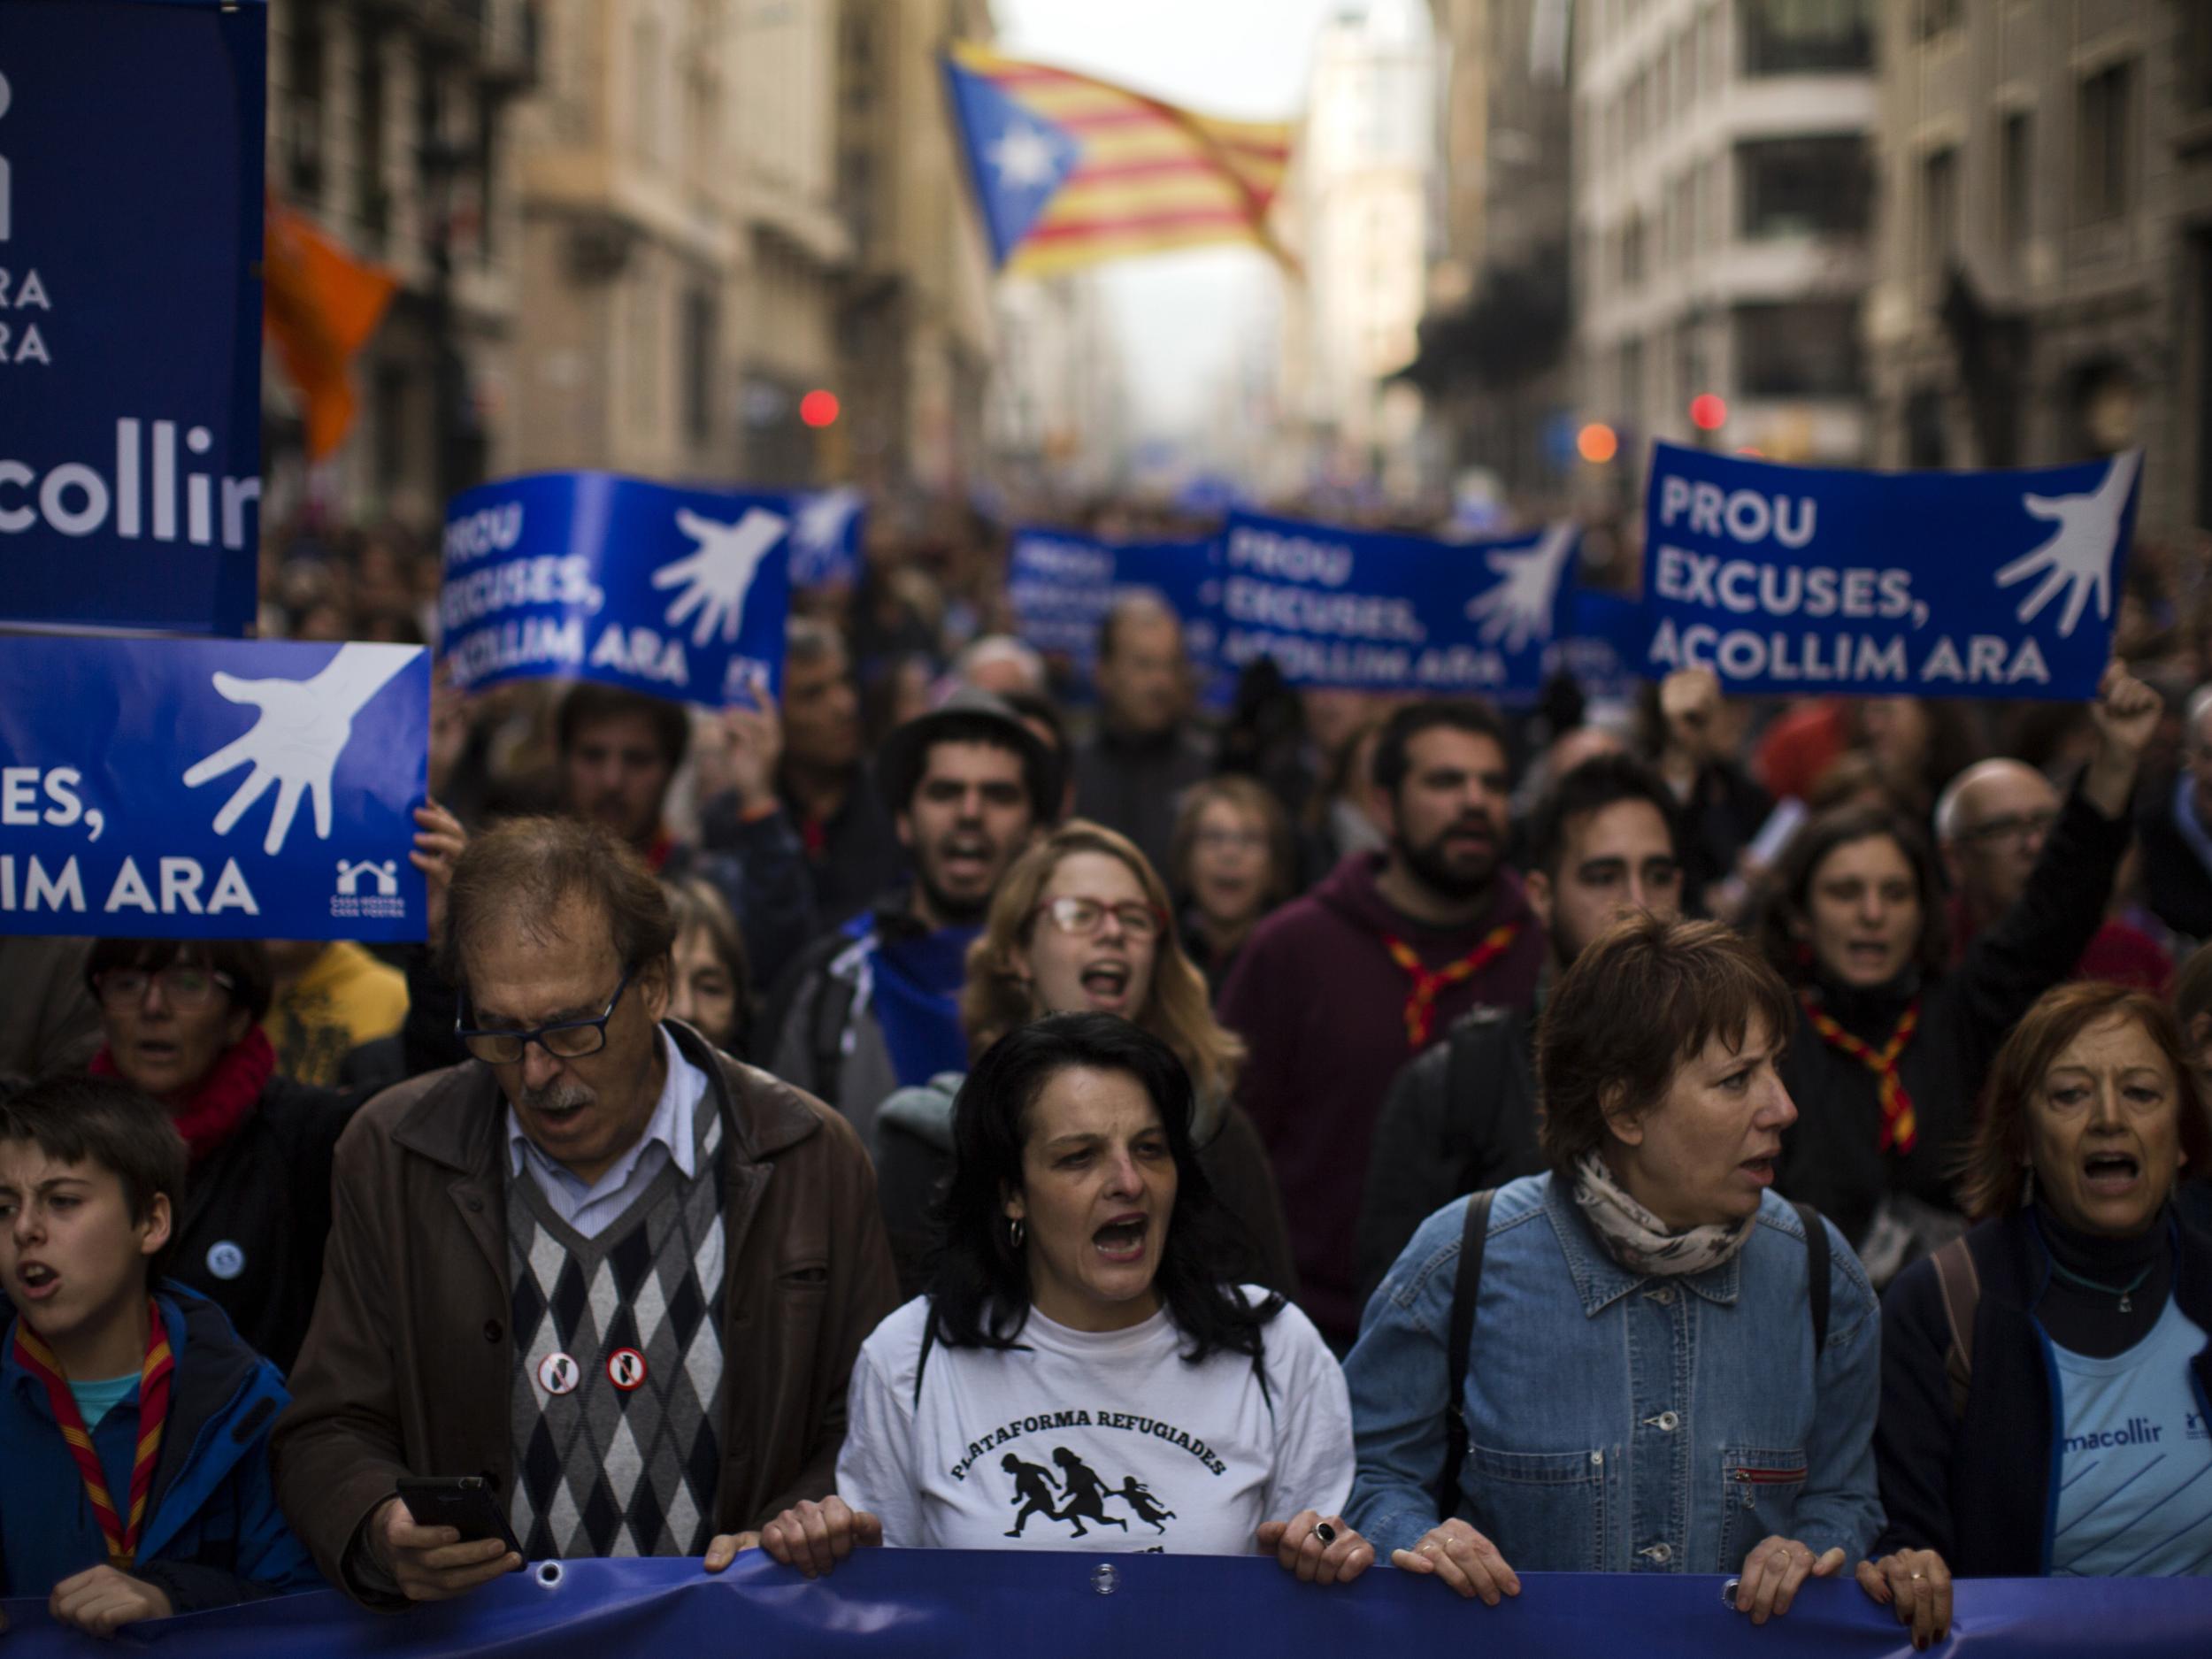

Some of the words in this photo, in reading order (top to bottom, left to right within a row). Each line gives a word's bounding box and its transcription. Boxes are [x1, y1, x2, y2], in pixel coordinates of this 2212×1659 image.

[1661, 474, 1817, 549] PROU
[1228, 526, 1353, 588] PROU
[1655, 544, 1930, 629] EXCUSES,
[589, 623, 689, 687] ARA
[1648, 618, 1909, 681] ACOLLIM
[1921, 634, 2050, 685] ARA
[2, 766, 104, 842] ES,
[0, 854, 87, 913] IM
[104, 855, 260, 915] ARA
[950, 1410, 1092, 1481] PLATAFORMA
[1097, 1410, 1227, 1477] REFUGIADES
[2063, 1417, 2162, 1453] macollir
